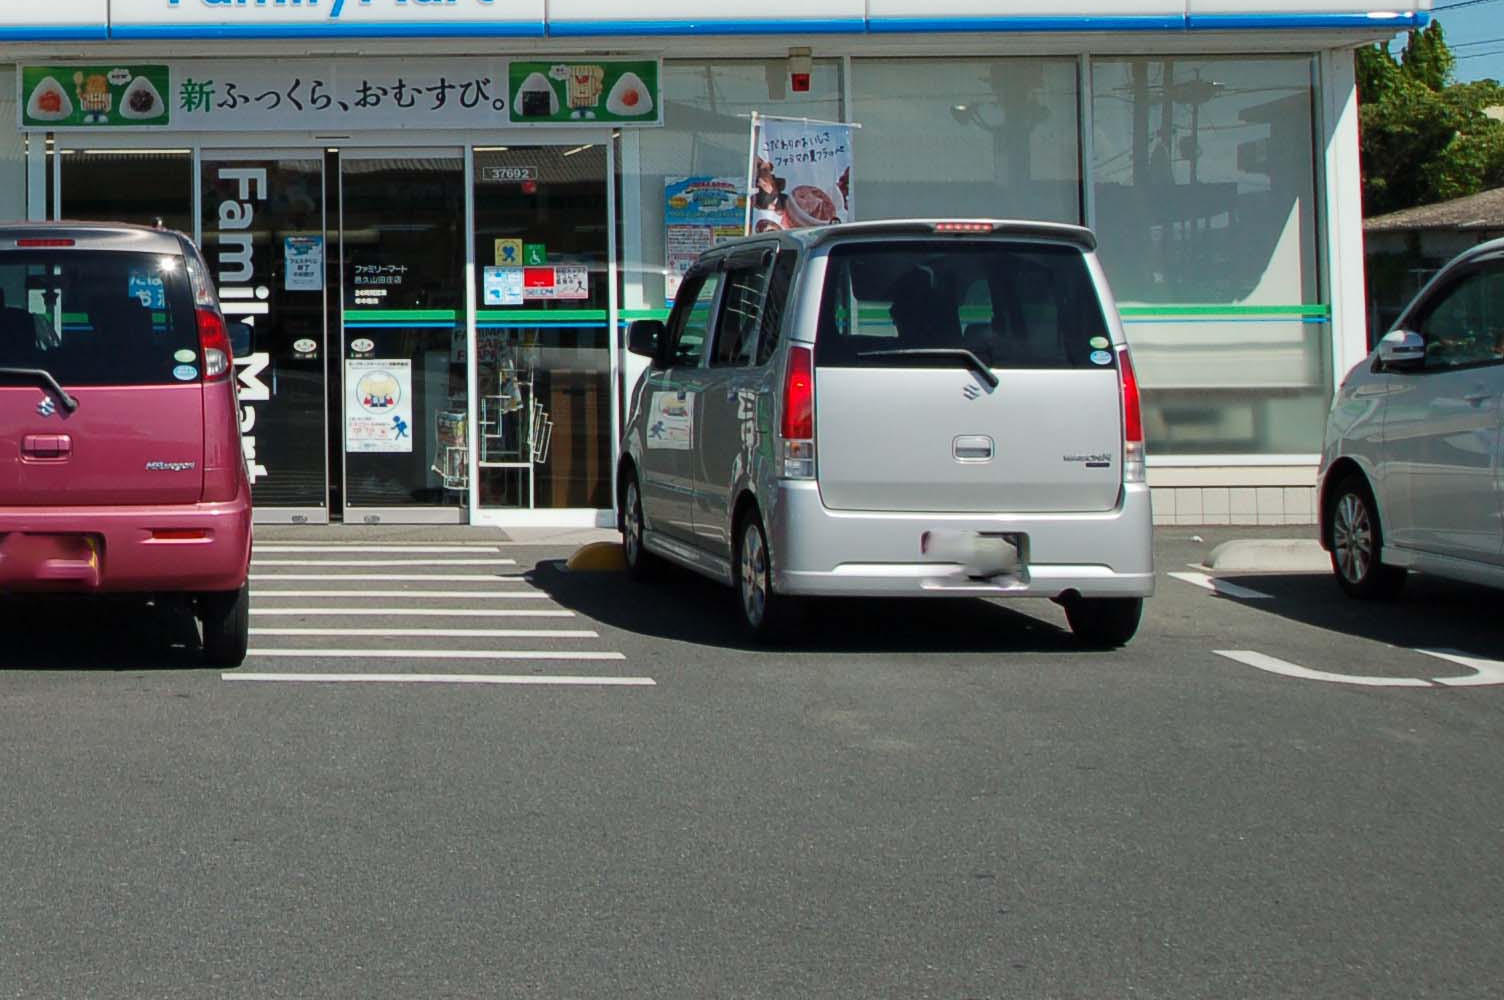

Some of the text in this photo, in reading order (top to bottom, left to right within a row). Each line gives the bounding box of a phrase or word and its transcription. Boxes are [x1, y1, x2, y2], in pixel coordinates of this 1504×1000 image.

[179, 77, 505, 112] 新ふっくら、おむすび。
[492, 168, 529, 179] 37692
